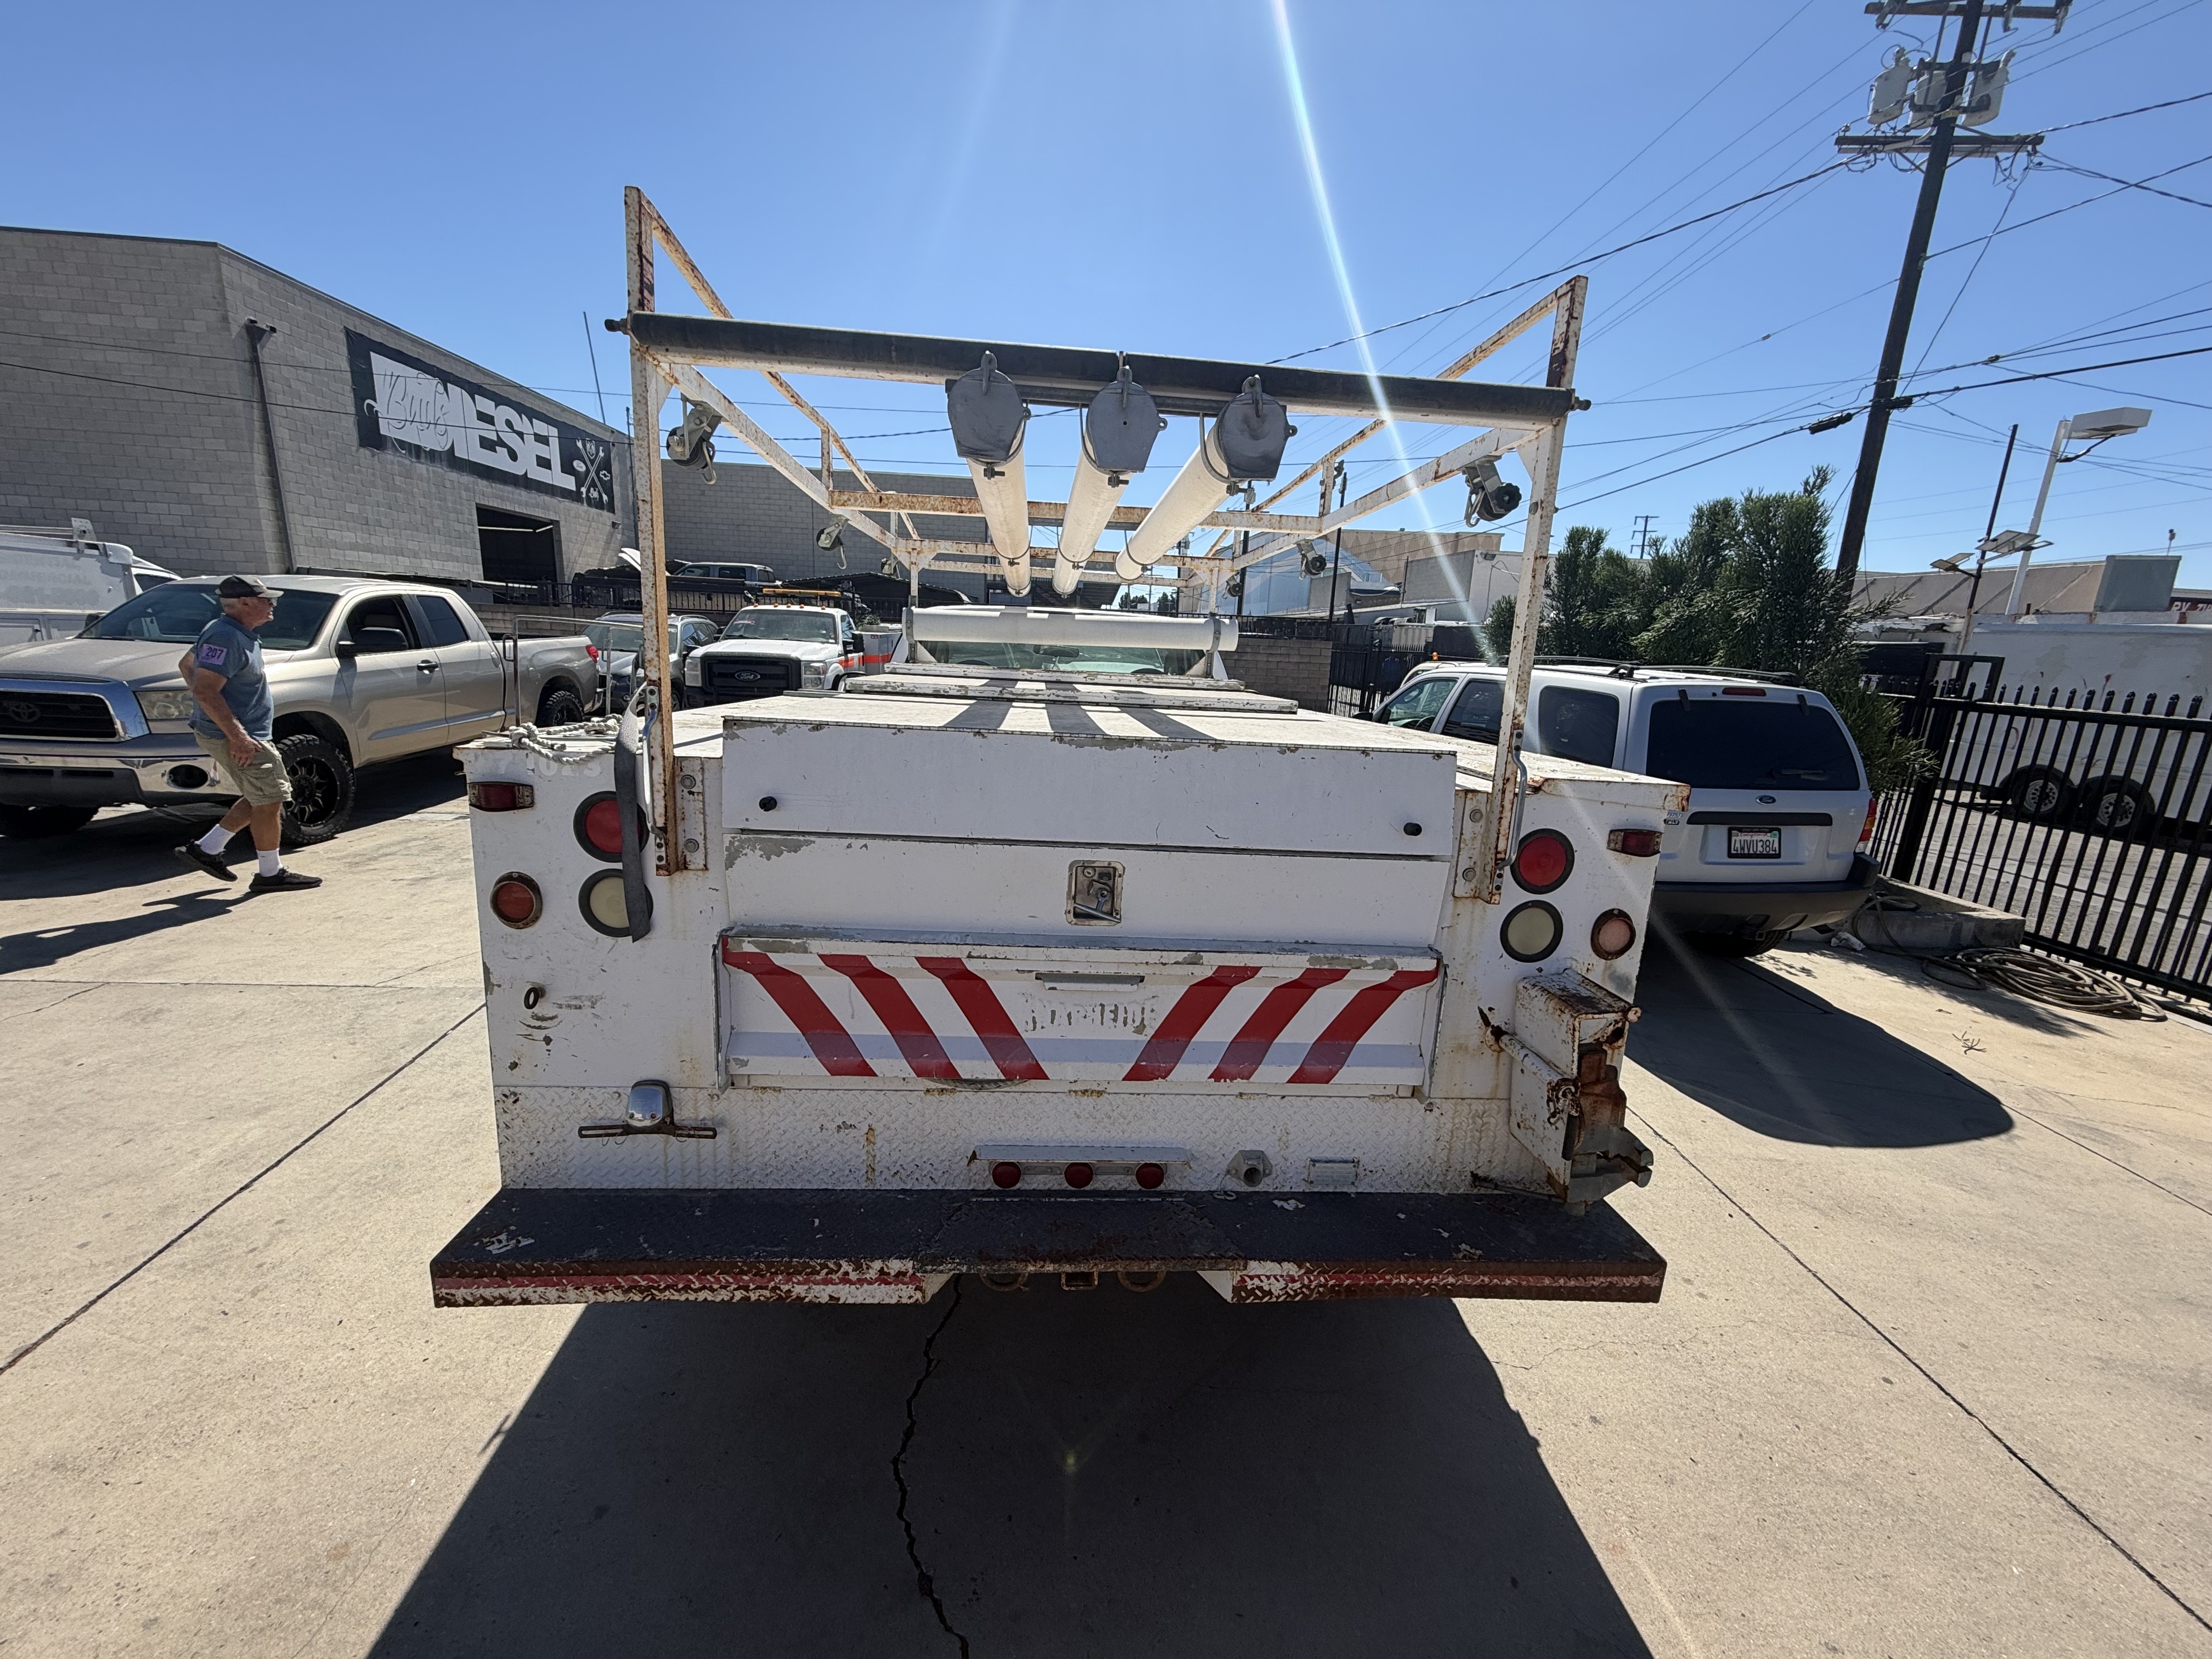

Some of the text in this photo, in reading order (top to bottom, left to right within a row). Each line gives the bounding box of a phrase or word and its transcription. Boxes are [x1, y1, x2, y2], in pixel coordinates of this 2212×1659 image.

[2170, 601, 2192, 612] RV
[206, 645, 224, 659] 207
[1733, 839, 1778, 854] 4WVU384
